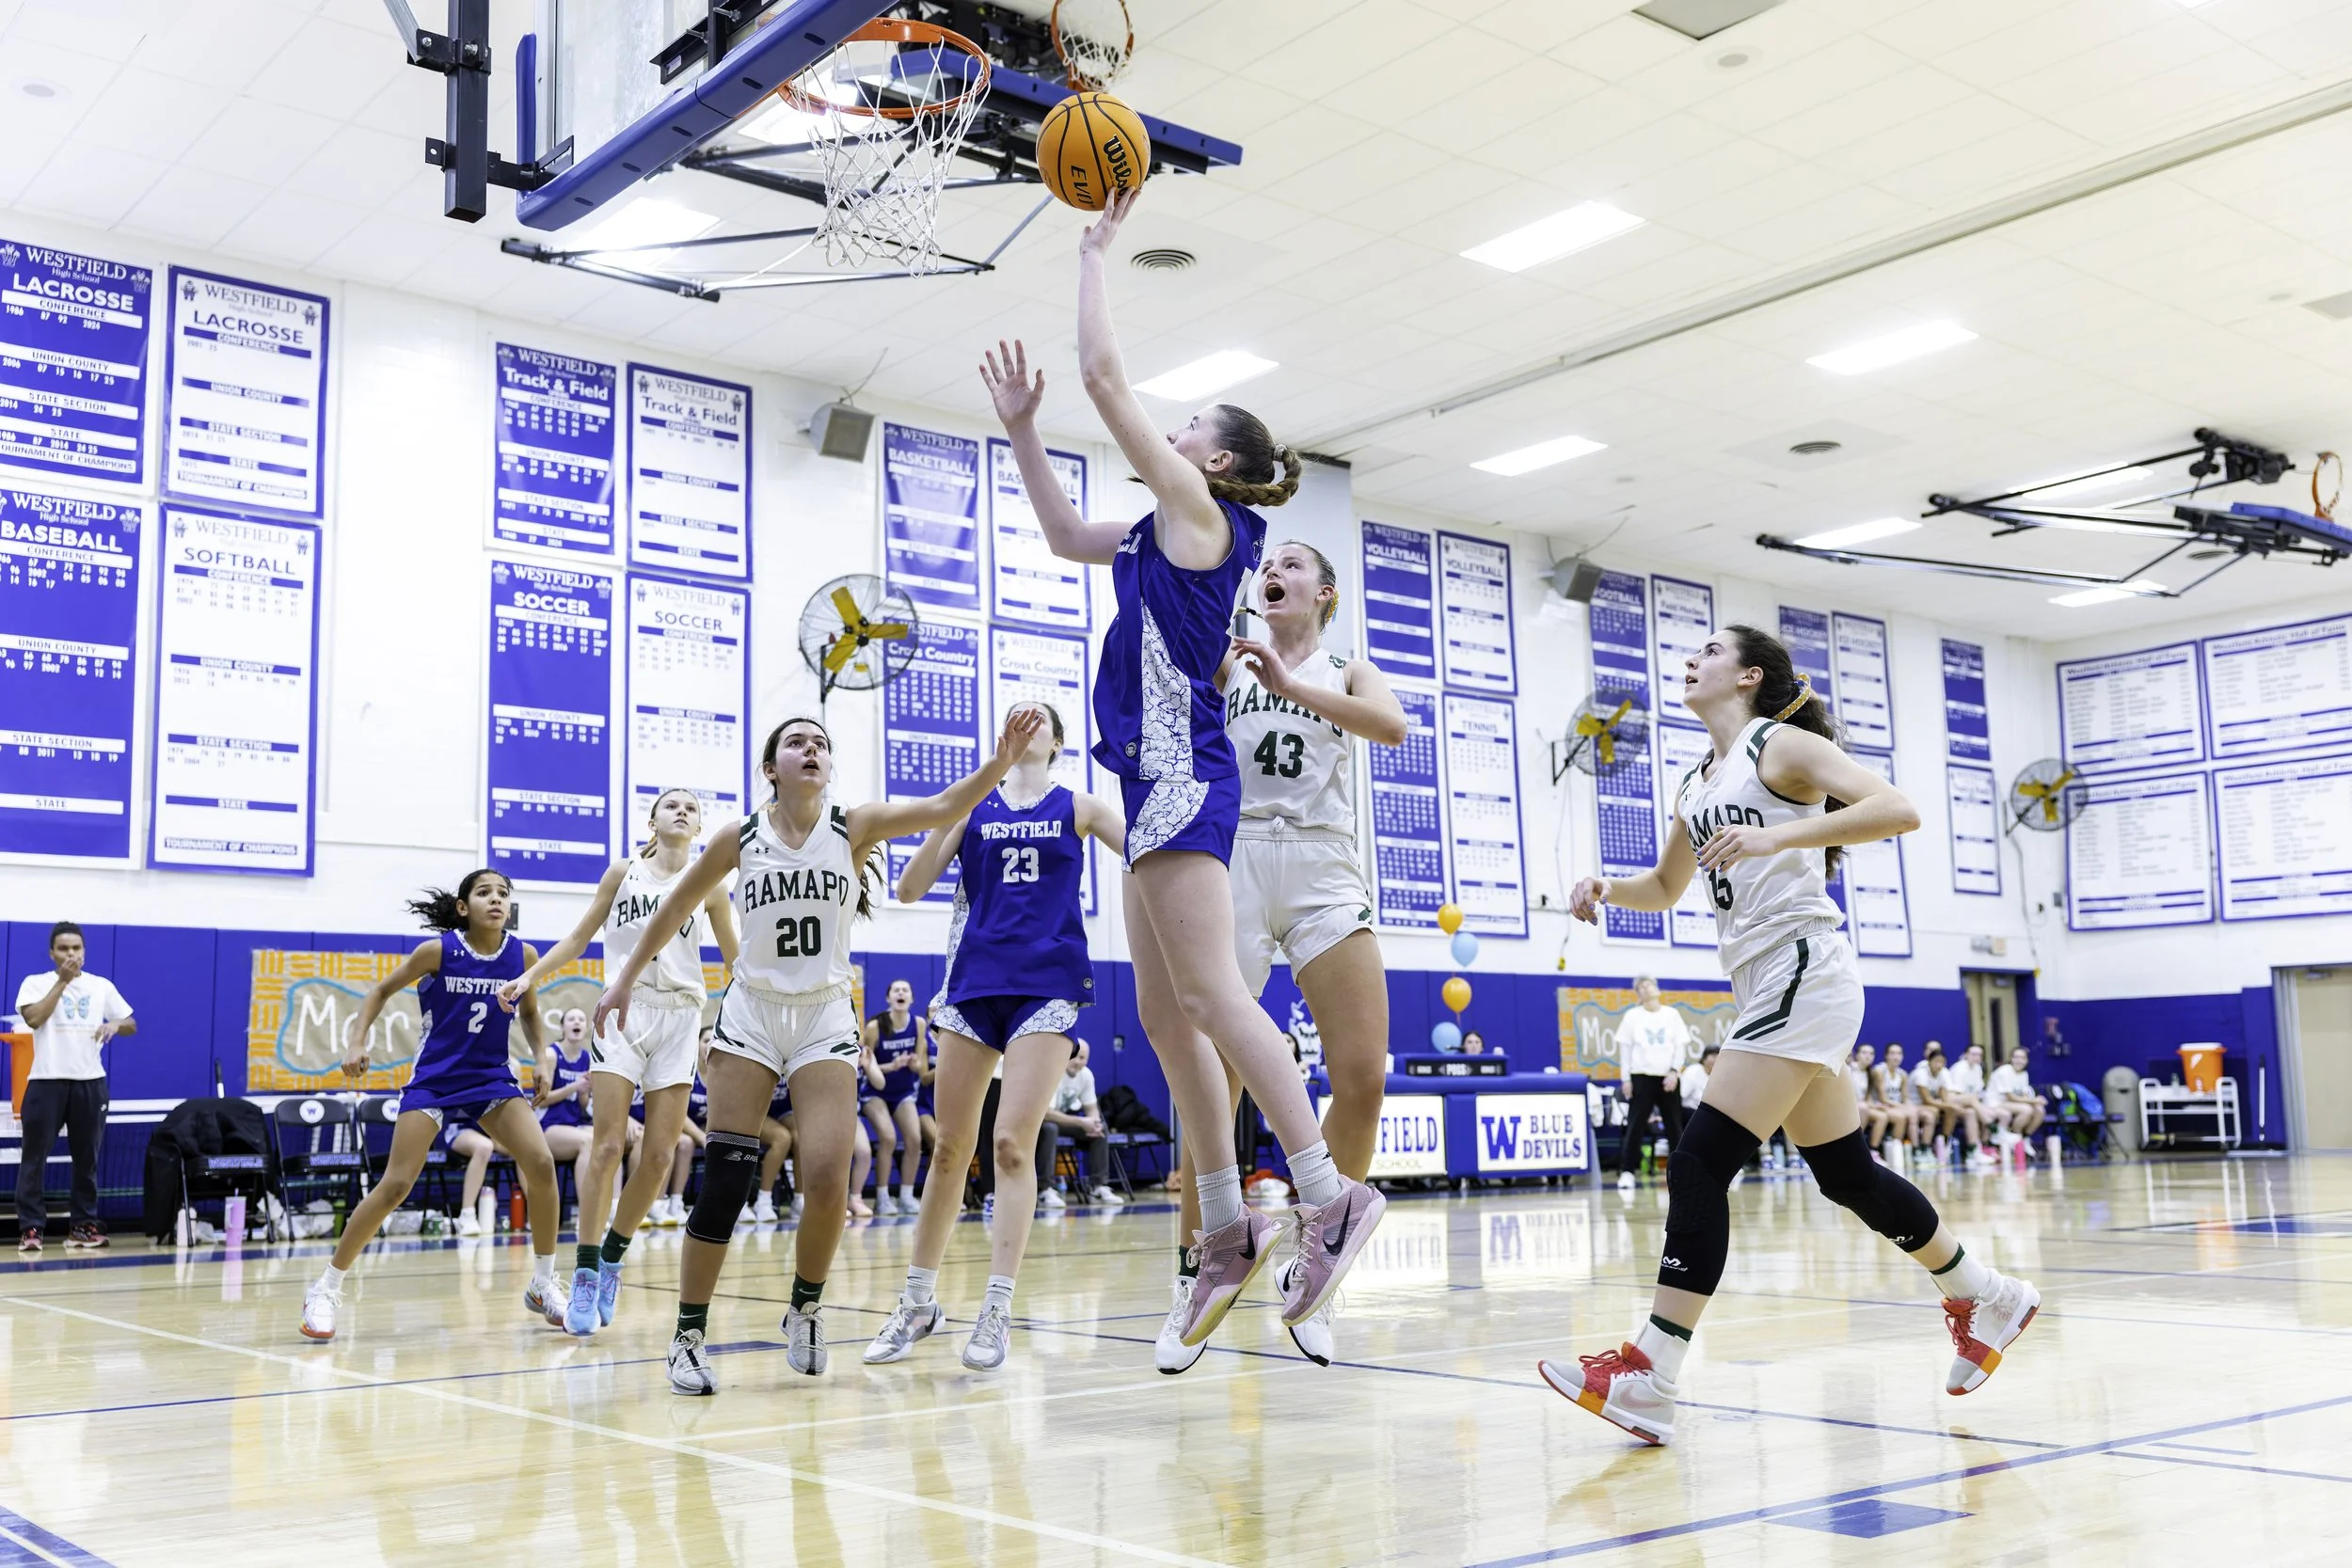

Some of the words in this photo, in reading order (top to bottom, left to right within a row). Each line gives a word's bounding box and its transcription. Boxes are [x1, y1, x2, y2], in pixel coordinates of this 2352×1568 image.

[1103, 134, 1133, 198] Wilso
[25, 246, 127, 280] WESTFIELD
[52, 267, 71, 278] High
[13, 273, 135, 312] LACROSSE
[205, 283, 297, 314] WESTFIELD
[40, 299, 106, 321] CONFERENCE
[194, 310, 304, 344] LACROSSE
[32, 351, 65, 363] UNION
[69, 358, 109, 372] COUNTY
[518, 348, 597, 376] WESTFIELD
[502, 366, 549, 389] Track
[553, 378, 564, 392] &
[569, 380, 609, 401] Field
[655, 377, 727, 403] WESTFIELD
[29, 392, 57, 403] STATE
[64, 399, 106, 412] SECTION
[531, 395, 582, 411] CONFERENCE
[642, 395, 683, 416] Track
[688, 406, 696, 418] &
[703, 407, 738, 426] Field
[51, 428, 80, 438] STATE
[901, 428, 964, 451] WESTFIELD
[1, 444, 59, 459] OURNAMENT
[78, 456, 133, 470] CHAMPIONS
[888, 447, 976, 477] BASKETBALL
[997, 470, 1077, 495] BASLL
[12, 492, 117, 521] WESTFIELD
[40, 512, 59, 523] High
[1, 520, 123, 553] BASEBALL
[196, 519, 289, 544] WESTFIELD
[27, 546, 94, 561] CONFERENCE
[183, 546, 296, 576] SOFTBALL
[1364, 542, 1429, 564] VOLLEYBALL
[513, 564, 594, 590] WESTFIELD
[1445, 558, 1503, 578] VOLLEYBALL
[514, 591, 591, 616] SOCCER
[653, 585, 725, 607] WESTFIELD
[655, 610, 723, 631] SOCCER
[19, 639, 51, 649] UNION
[56, 642, 96, 654] COUNTY
[888, 641, 923, 658] Cross
[924, 646, 976, 667] Country
[999, 657, 1031, 671] Cross
[1034, 661, 1079, 679] Country
[519, 710, 546, 719] UNION
[548, 713, 580, 722] COUNTY
[1461, 720, 1498, 734] TENNIS
[13, 734, 42, 744] STATE
[49, 737, 93, 748] SECTION
[1253, 730, 1305, 779] 43
[36, 800, 66, 808] STATE
[218, 799, 248, 810] STATE
[980, 820, 1062, 841] WESTFIELD
[1001, 847, 1040, 883] 23
[745, 869, 850, 914] RAMAPO
[617, 894, 695, 939] RAMO
[776, 915, 822, 958] 20
[444, 975, 509, 995] WESTFI
[468, 1002, 488, 1034] 2
[772, 1086, 787, 1101] 25
[1530, 1115, 1574, 1134] BLUE
[1481, 1116, 1521, 1160] W
[1523, 1138, 1581, 1160] DEVILS
[1375, 1158, 1422, 1170] SCHOOL
